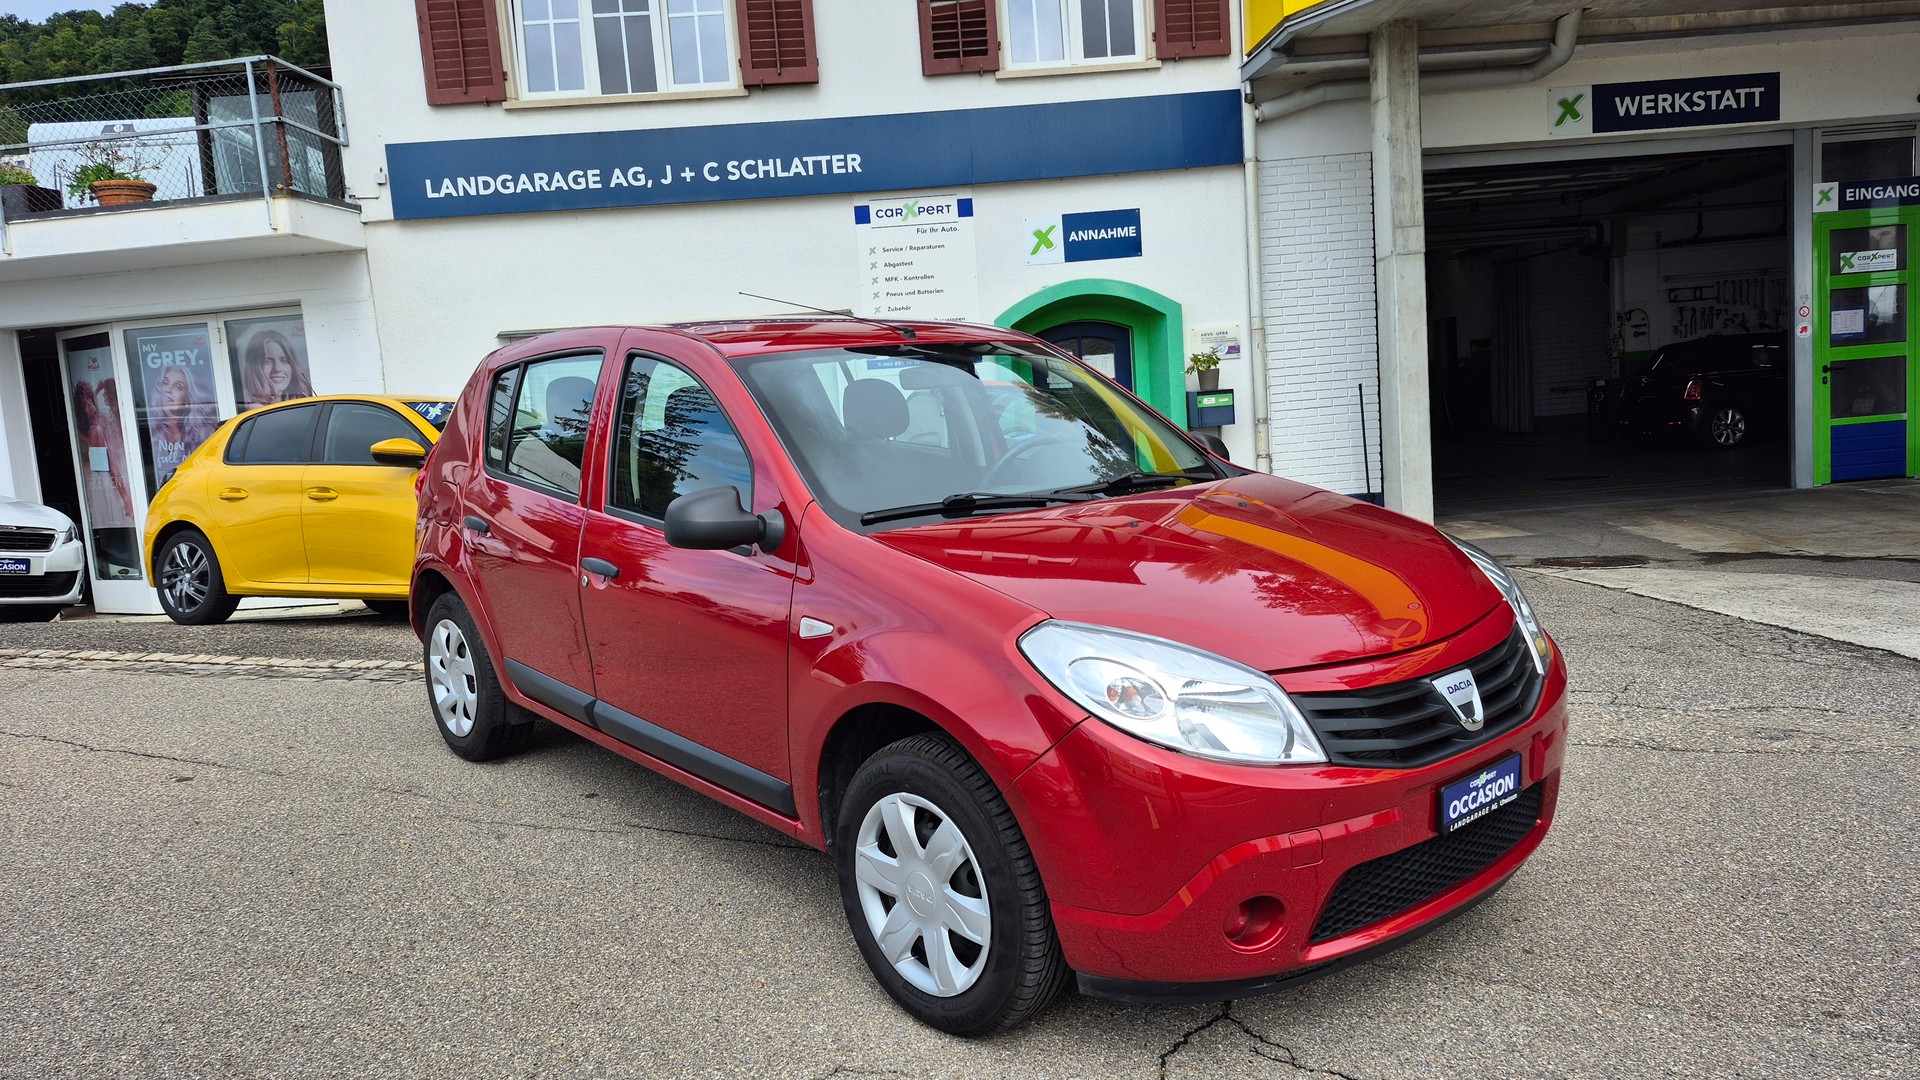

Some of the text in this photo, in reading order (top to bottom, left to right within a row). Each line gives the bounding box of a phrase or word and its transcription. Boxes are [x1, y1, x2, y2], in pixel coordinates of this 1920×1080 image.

[1614, 87, 1765, 117] WERKSTATT
[425, 154, 863, 199] LANDGARAGE AG, J + C SCHLATTER
[1845, 183, 1920, 202] EINGANG
[916, 227, 927, 235] Für
[1069, 226, 1137, 242] ANNAHME
[909, 243, 945, 252] Reparaturen
[883, 260, 913, 269] Abgastest
[886, 290, 903, 298] Pneus
[917, 288, 944, 296] Batterien
[142, 343, 157, 352] MY
[146, 348, 204, 369] GREY.
[1446, 679, 1473, 695] DACIA
[1449, 773, 1514, 819] OCCASION
[1450, 806, 1490, 832] LANDGARAGE
